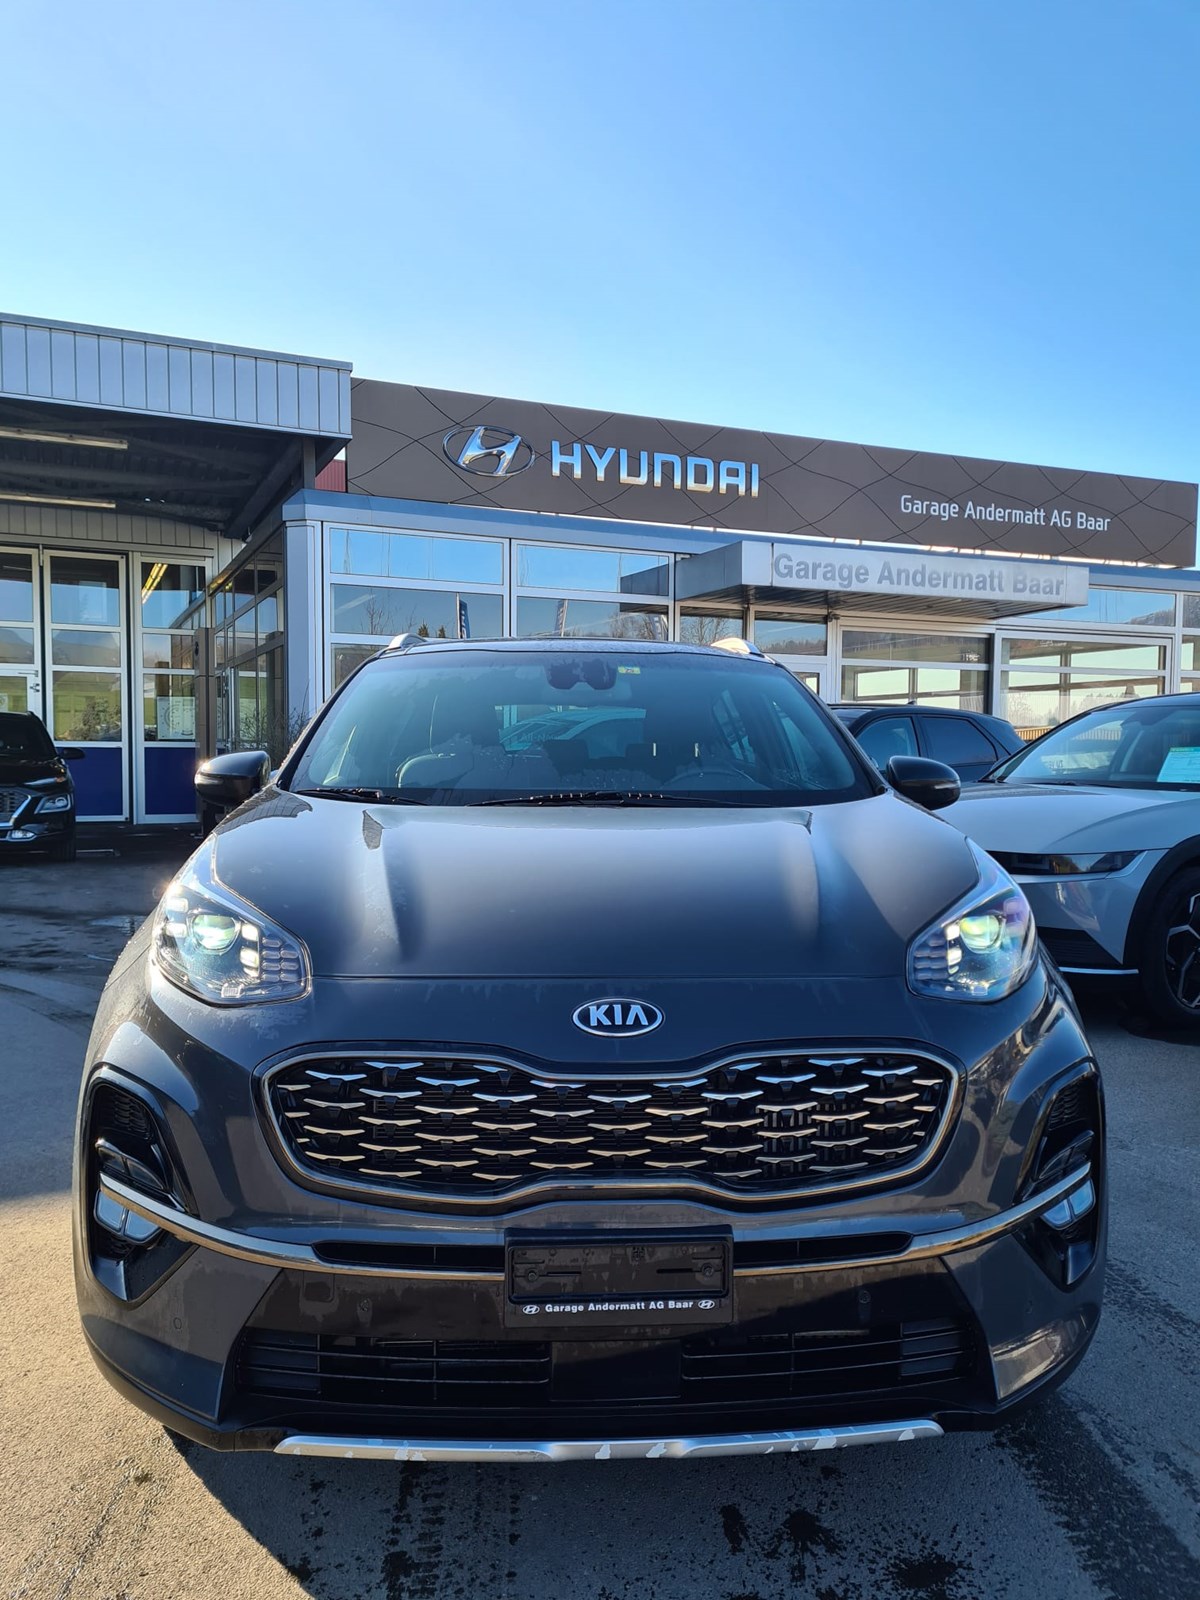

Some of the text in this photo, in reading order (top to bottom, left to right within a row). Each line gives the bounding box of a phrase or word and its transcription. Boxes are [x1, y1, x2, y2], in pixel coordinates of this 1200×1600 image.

[551, 440, 759, 498] HYUNDAI
[900, 495, 1111, 531] Garage Andermatt AG Baar
[773, 552, 1065, 596] Garage Andermatt Baar
[588, 1004, 649, 1026] KIA
[545, 1300, 694, 1314] Garage Andermatt AG Baar
